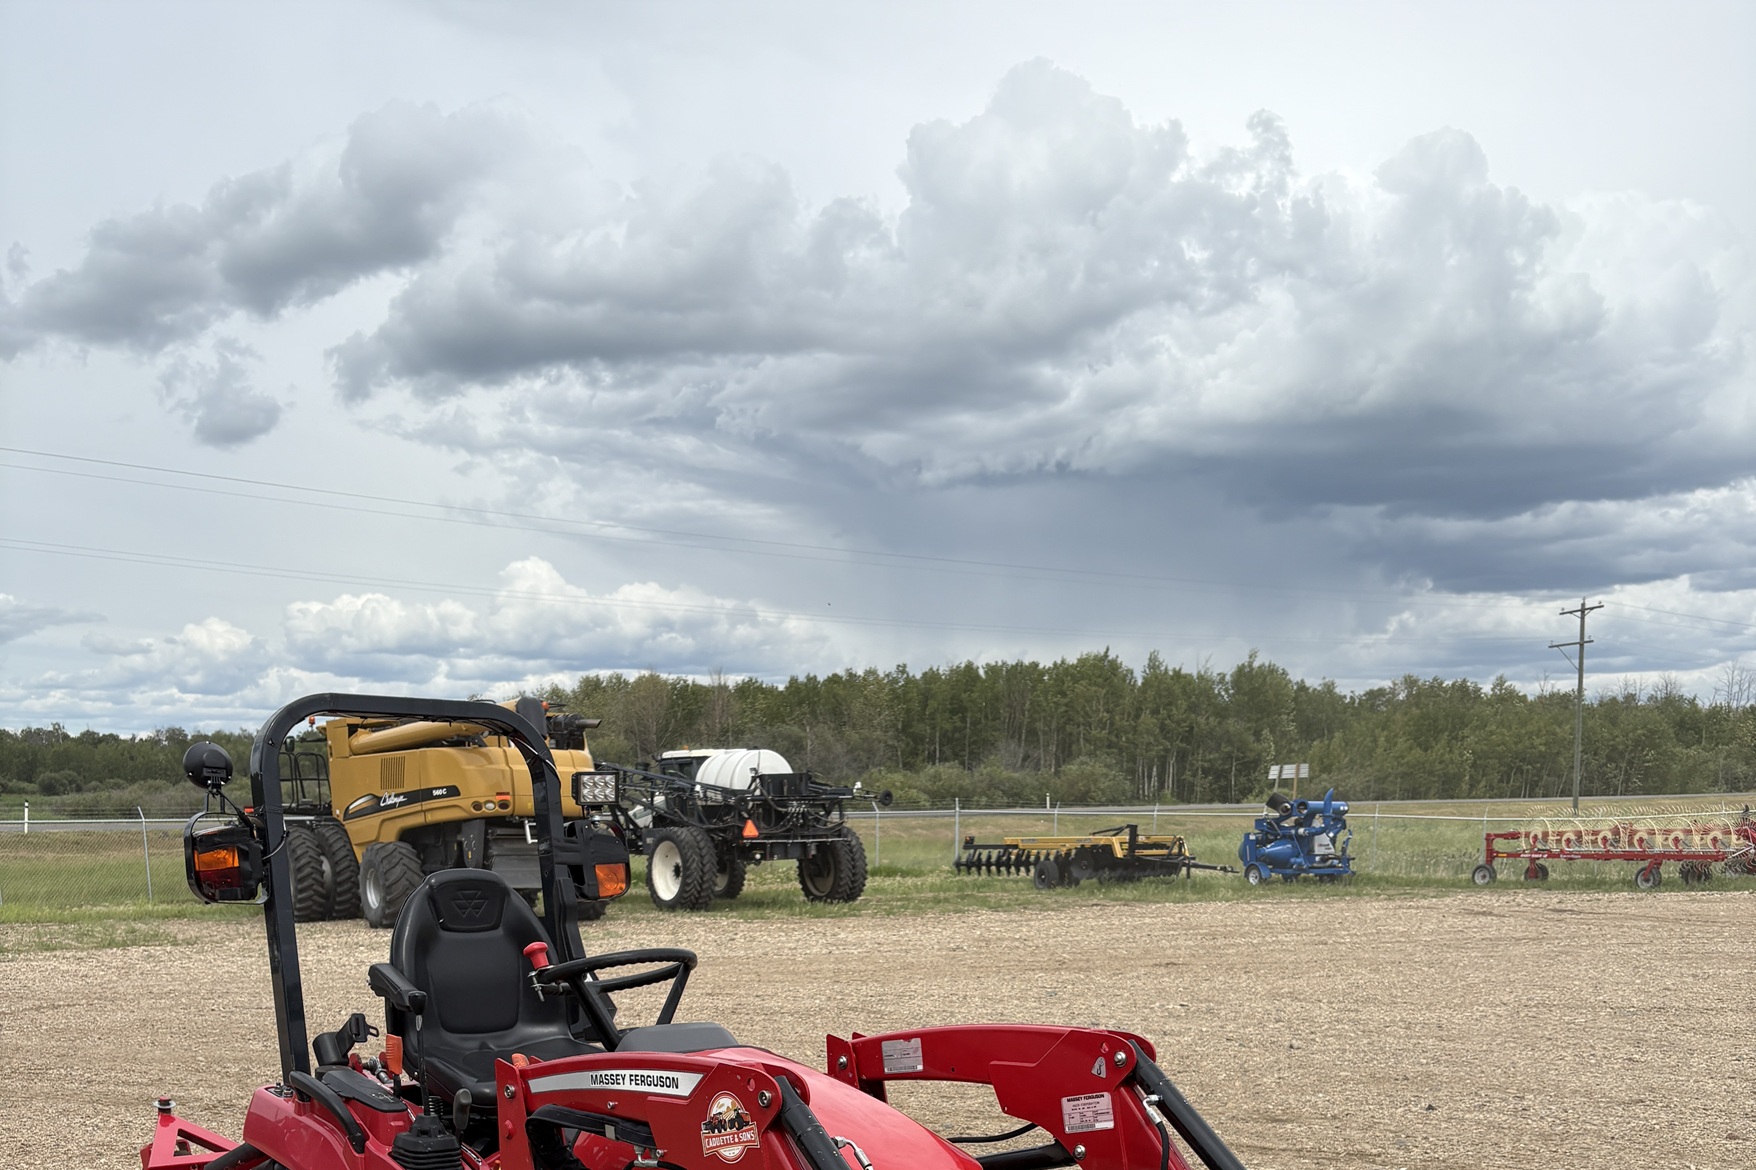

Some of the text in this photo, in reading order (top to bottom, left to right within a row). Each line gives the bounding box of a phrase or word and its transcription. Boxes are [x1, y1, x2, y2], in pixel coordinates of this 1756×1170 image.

[590, 1072, 679, 1090] MASSEY FERGUSON
[739, 1130, 755, 1142] SONS
